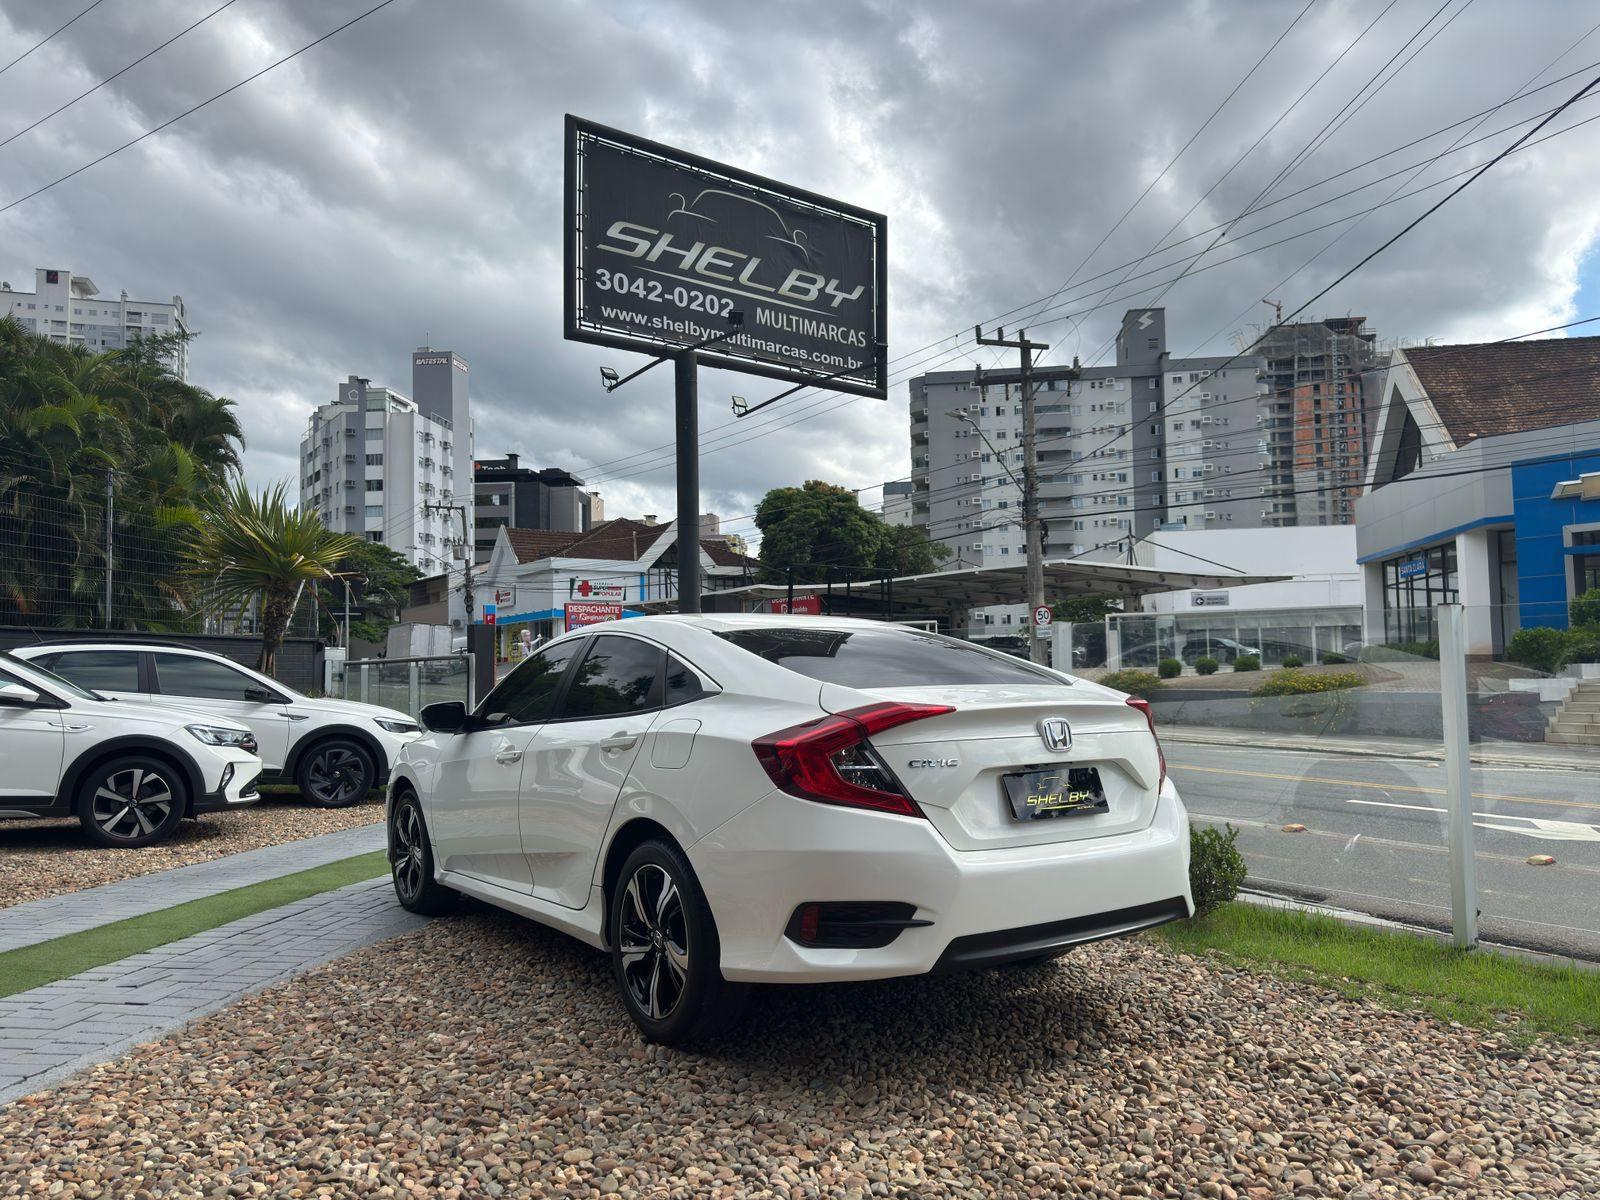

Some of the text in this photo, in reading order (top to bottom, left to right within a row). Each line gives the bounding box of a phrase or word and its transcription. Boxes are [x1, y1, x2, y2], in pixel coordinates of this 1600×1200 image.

[596, 221, 865, 308] SHELBY
[595, 268, 735, 318] 3042-0202
[601, 305, 863, 369] www.shelbymultimarcas.com.br
[755, 306, 867, 348] MULTIMARCAS
[568, 605, 620, 614] DESPACHANTE
[1038, 610, 1049, 620] 50
[908, 758, 958, 768] CIVIC
[1027, 791, 1090, 806] SHELBY
